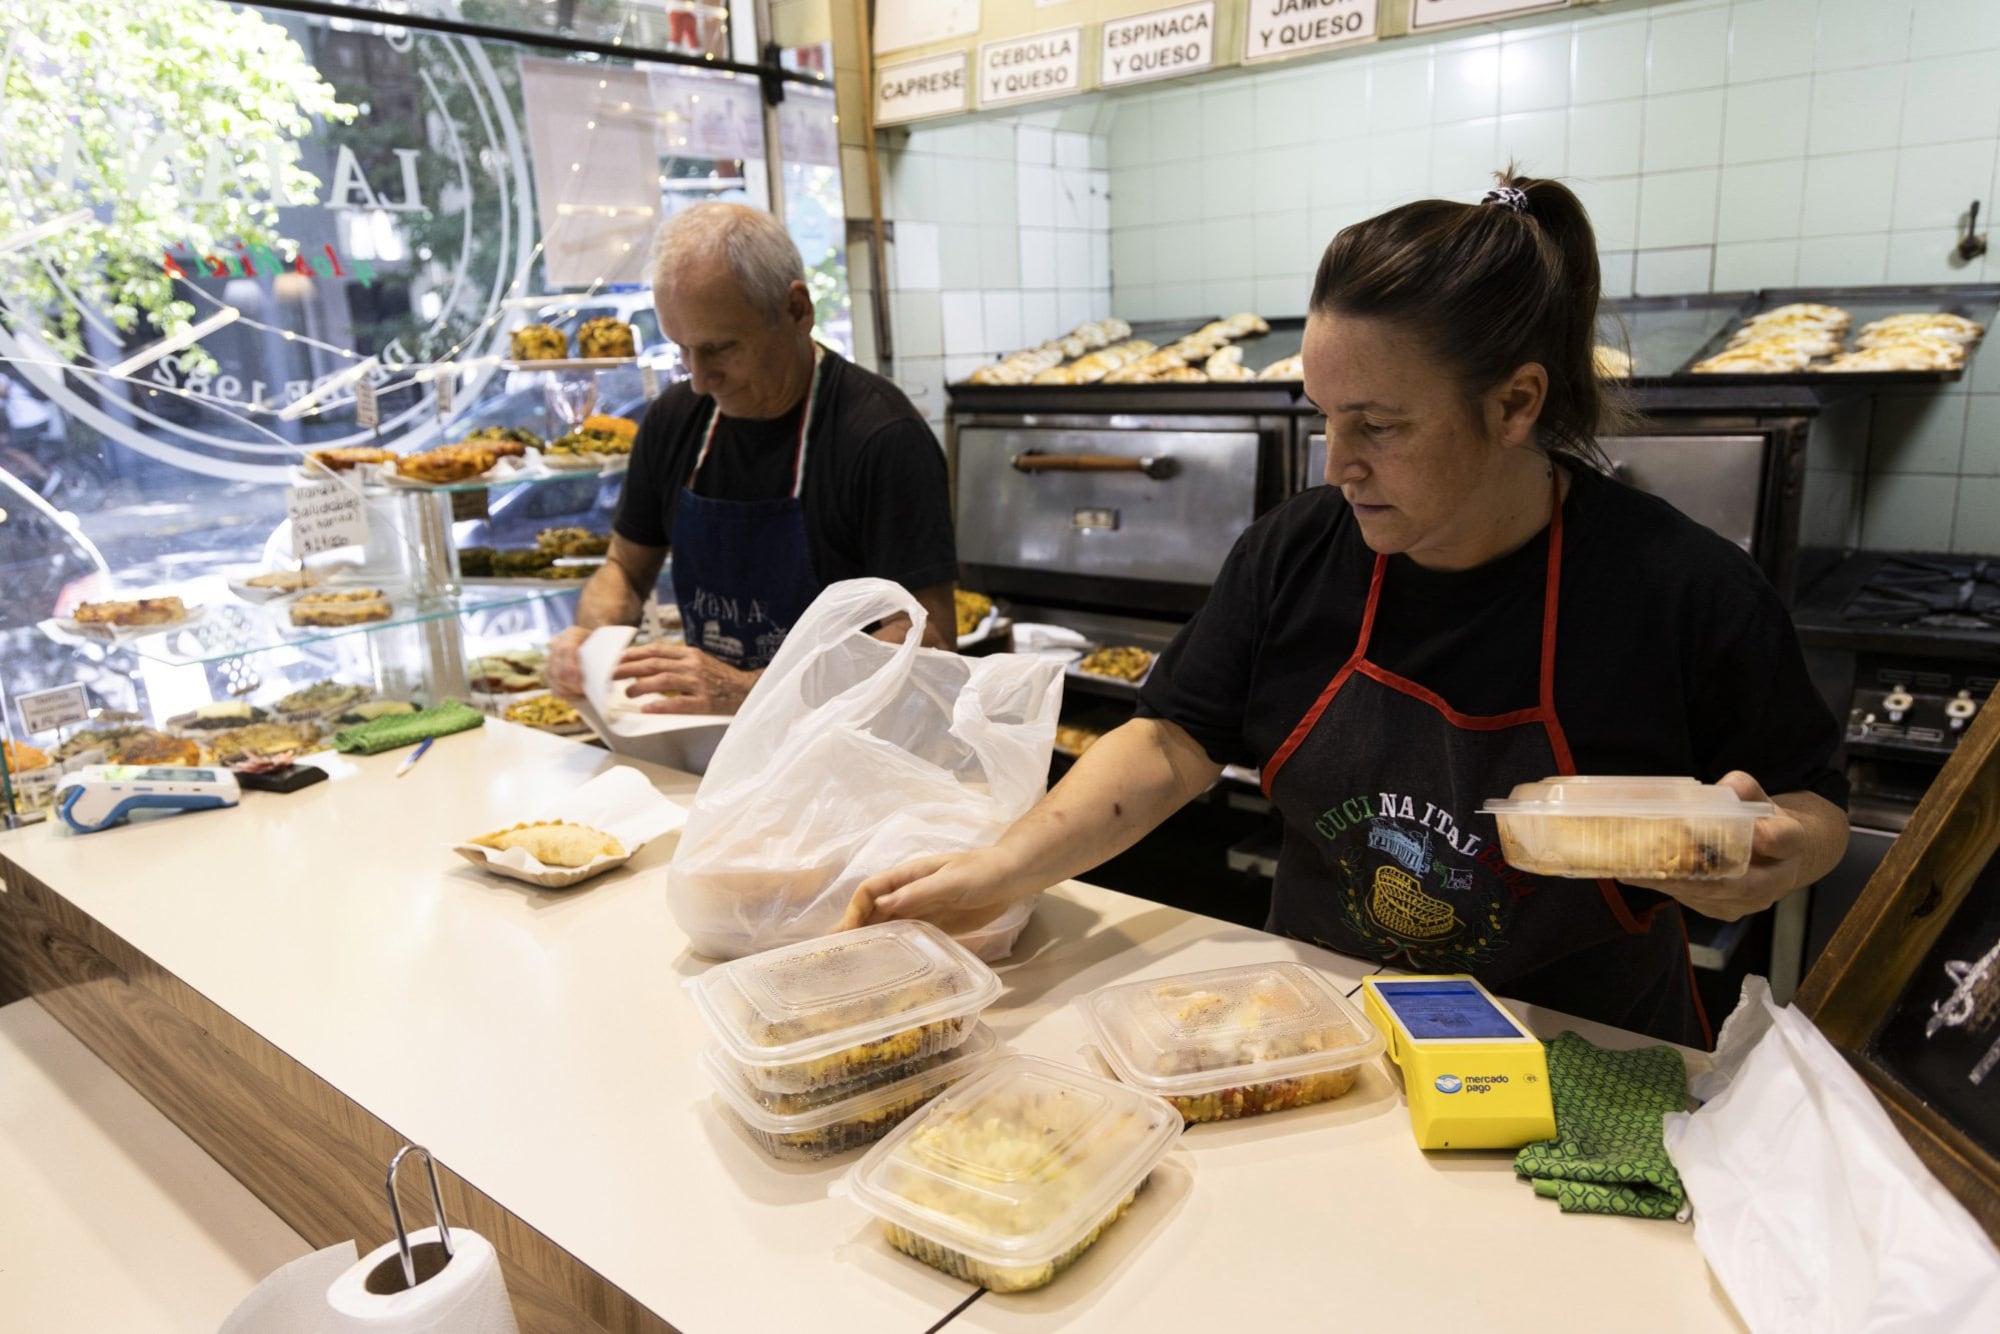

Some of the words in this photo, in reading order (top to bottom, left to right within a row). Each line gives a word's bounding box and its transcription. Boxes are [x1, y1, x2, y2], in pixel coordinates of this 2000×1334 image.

[1107, 12, 1209, 48] ESPINACA
[1259, 30, 1273, 48] Y
[1279, 12, 1363, 45] QUESO
[990, 37, 1072, 69] CEBOLLA
[1112, 59, 1124, 75] Y
[1128, 42, 1201, 72] QUESO
[881, 68, 962, 100] CAPRESE
[990, 78, 1001, 94] Y
[1005, 66, 1069, 92] QUESO
[1465, 1074, 1509, 1084] mercado
[1466, 1084, 1491, 1094] pago
